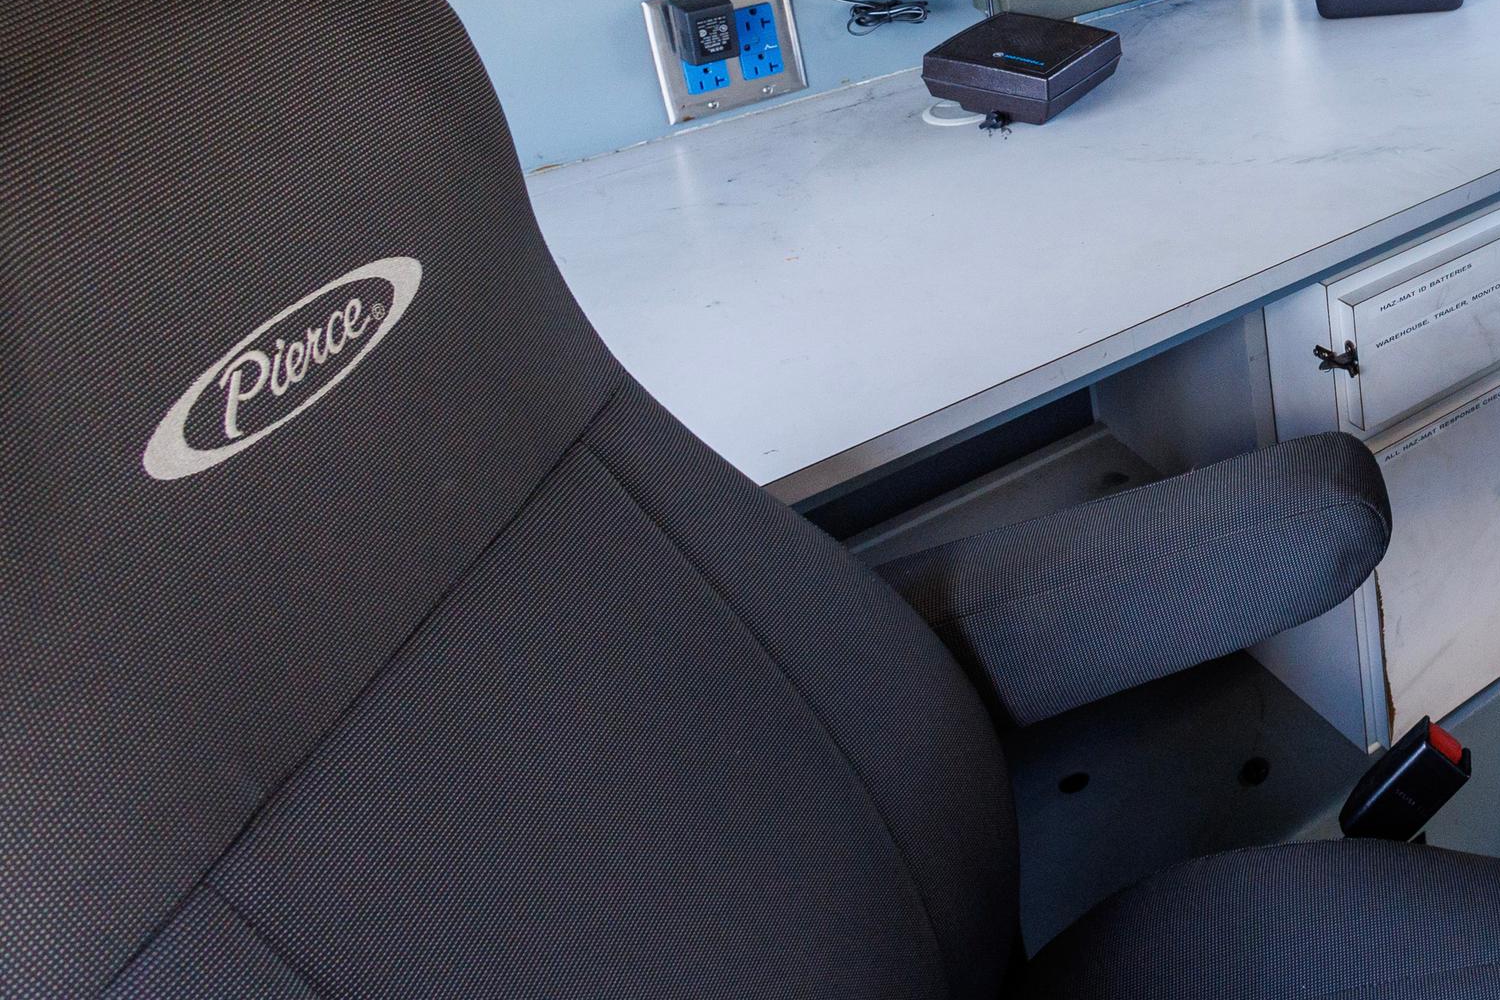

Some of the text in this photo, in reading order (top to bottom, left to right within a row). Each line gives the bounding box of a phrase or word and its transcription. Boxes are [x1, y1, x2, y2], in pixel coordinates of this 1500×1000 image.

[1380, 263, 1473, 312] HAZ-MAT ID BATTERIES
[219, 298, 371, 440] Pierce
[1384, 451, 1401, 462] ALL
[1402, 428, 1437, 451] HAZ-MAT
[1439, 403, 1480, 430] RESPONSE
